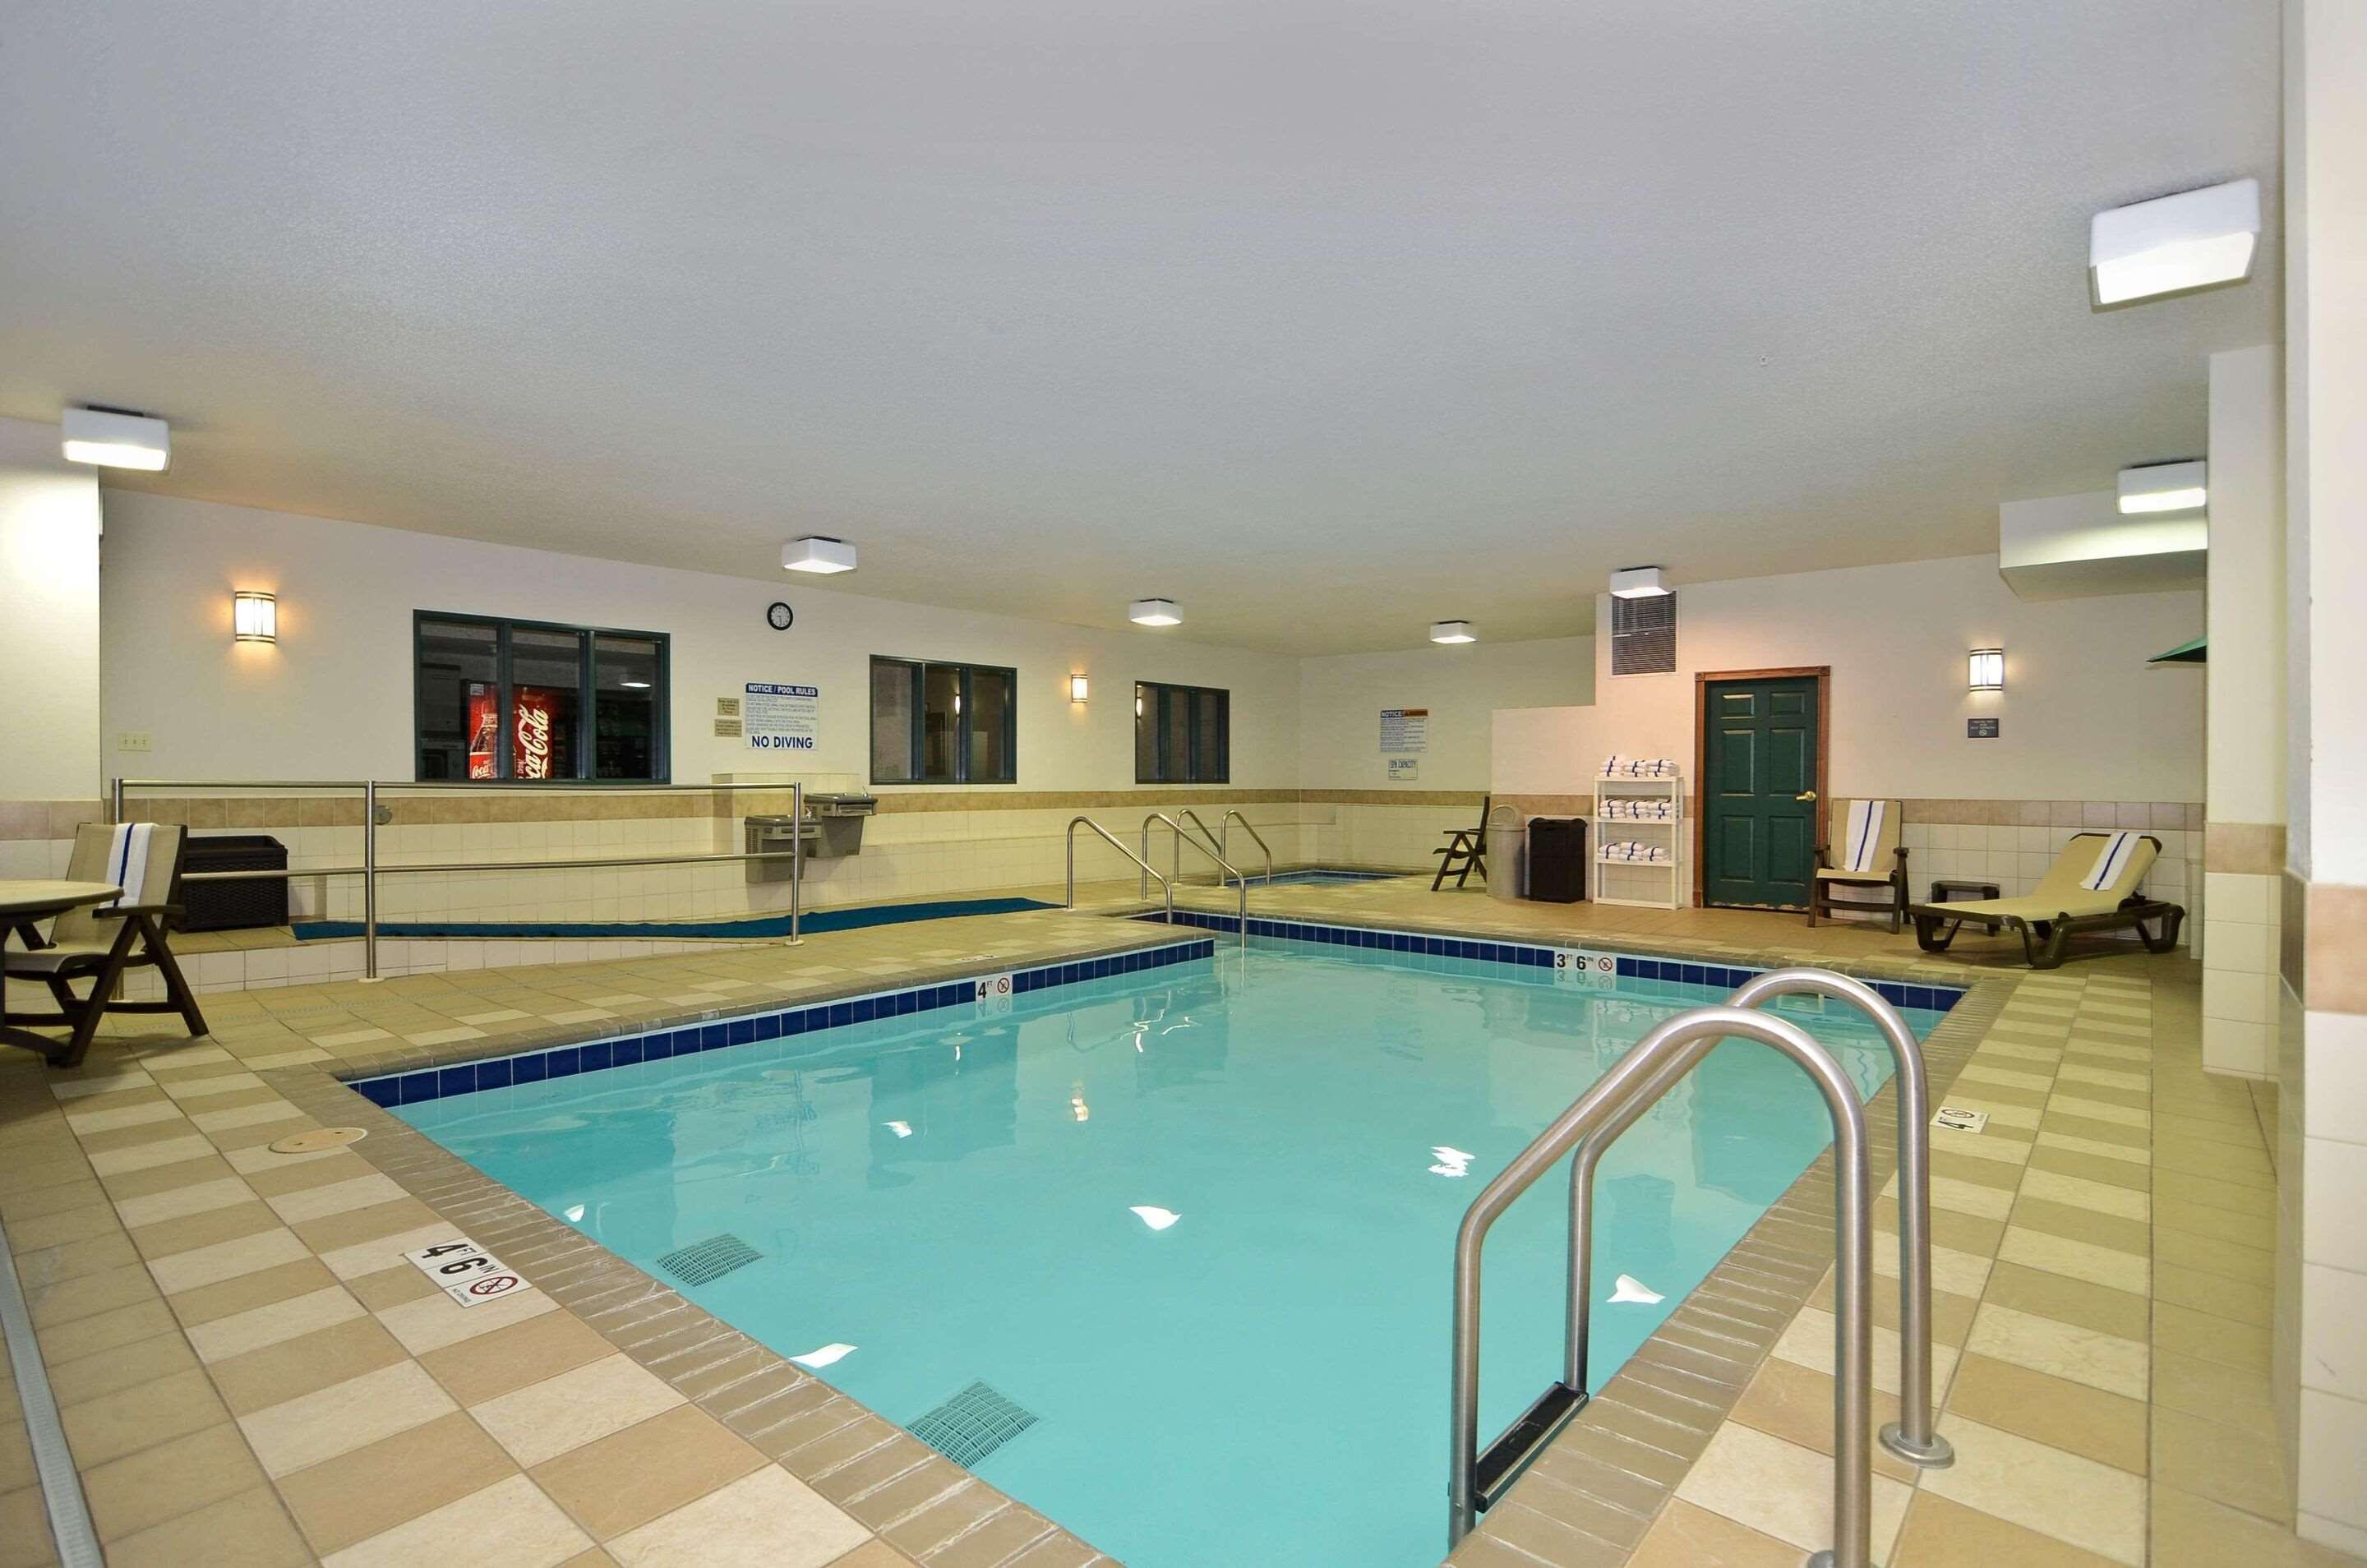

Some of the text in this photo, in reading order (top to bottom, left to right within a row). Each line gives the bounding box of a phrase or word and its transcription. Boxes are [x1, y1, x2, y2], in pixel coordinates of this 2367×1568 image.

[748, 684, 773, 693] NOTICE
[777, 686, 795, 694] POOL
[796, 687, 816, 695] RULES
[752, 736, 813, 749] NO DIVING
[1557, 953, 1566, 968] 3
[1576, 956, 1586, 970] 6
[978, 982, 987, 998] 4
[422, 1243, 500, 1275] 4 FT 6 IN
